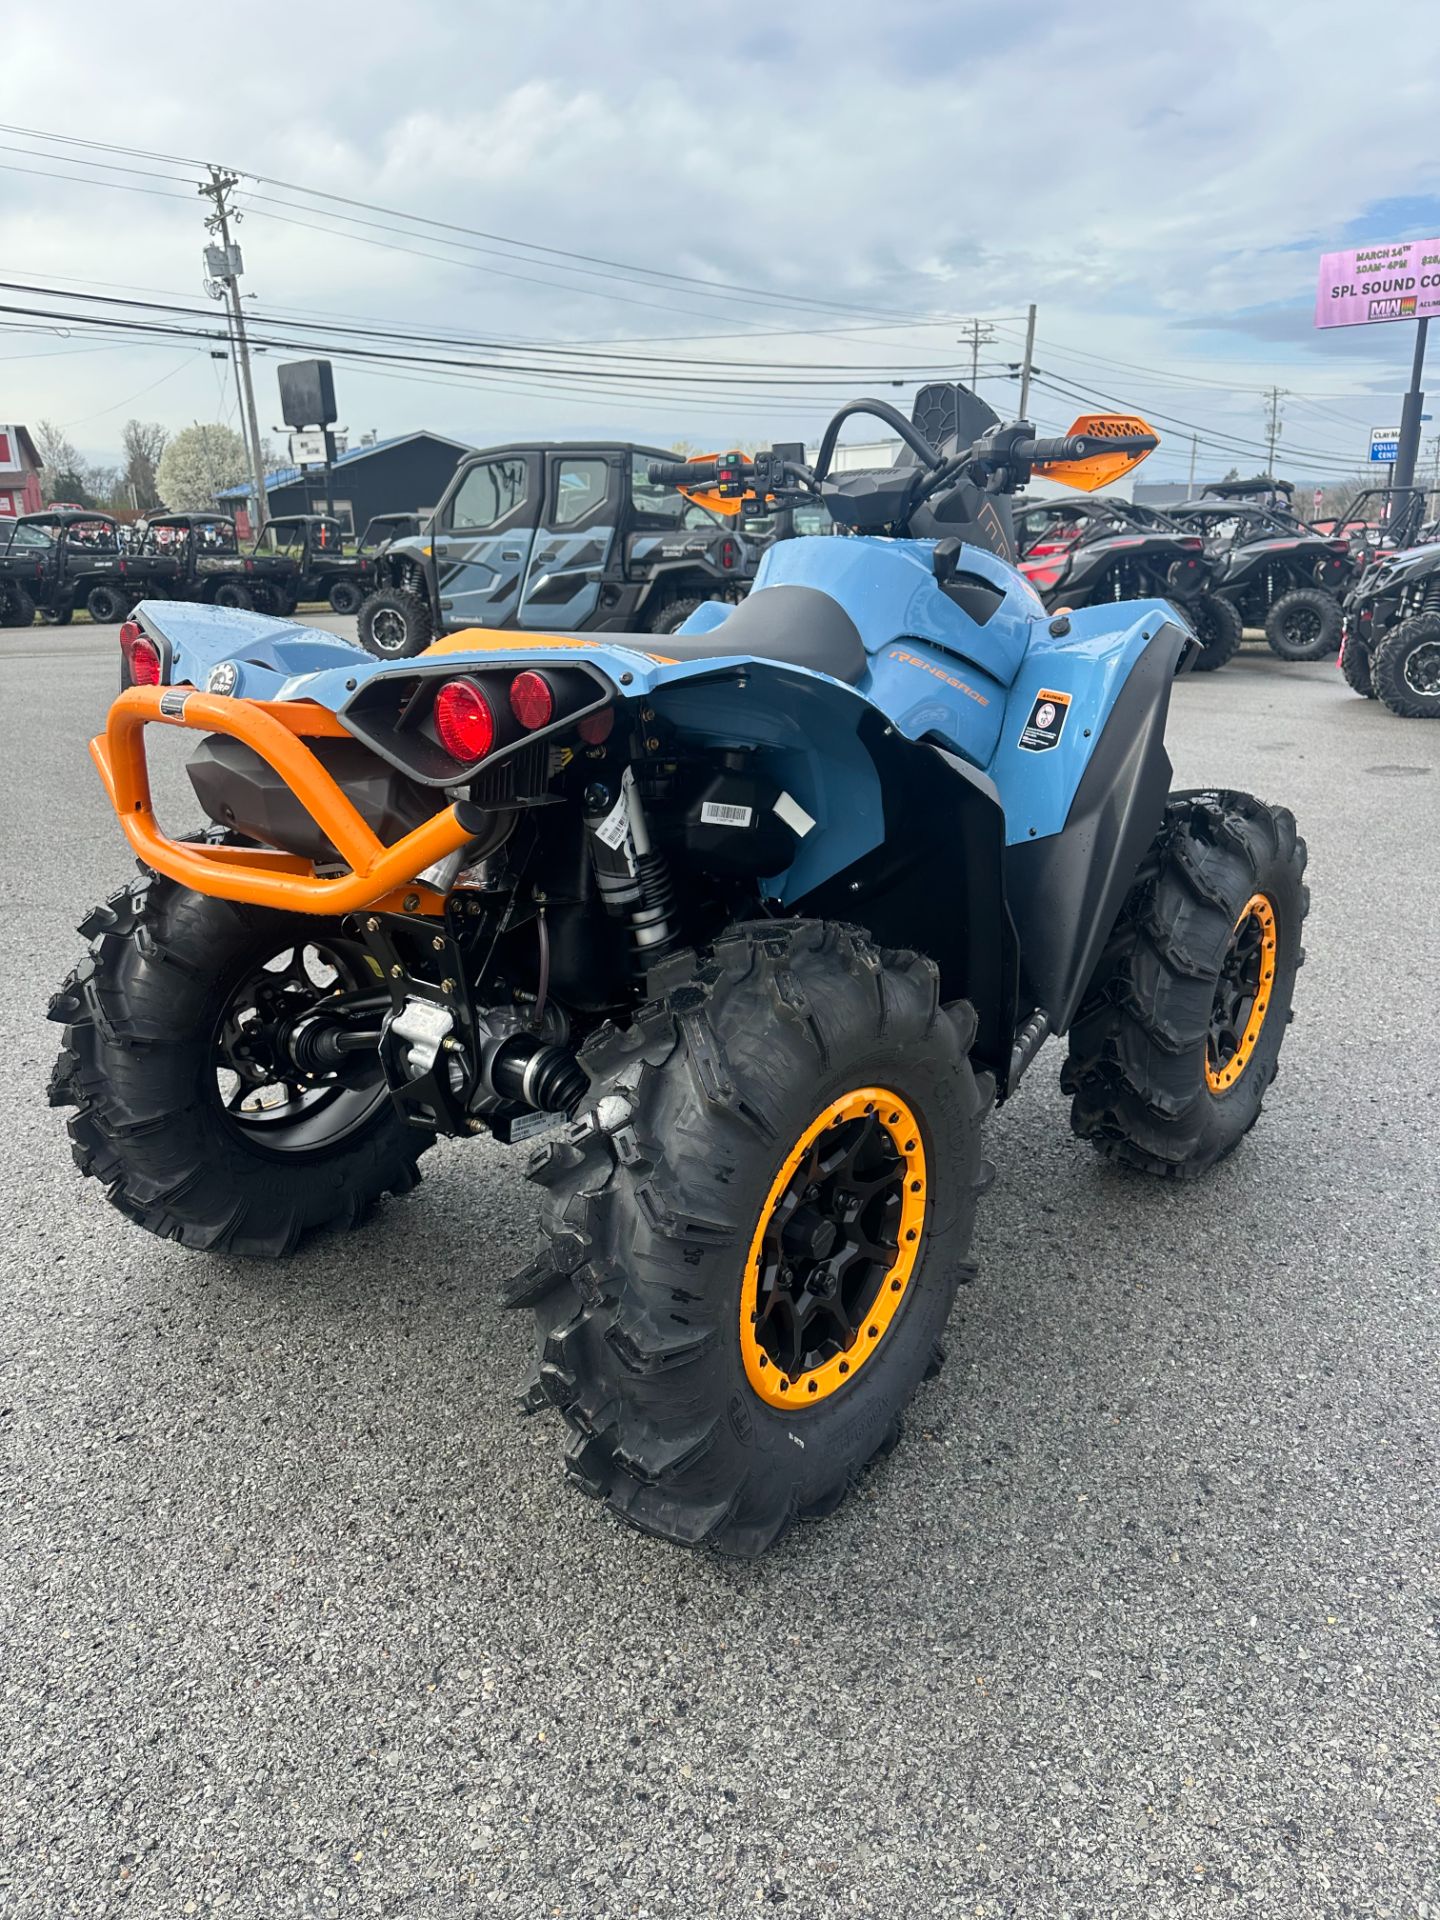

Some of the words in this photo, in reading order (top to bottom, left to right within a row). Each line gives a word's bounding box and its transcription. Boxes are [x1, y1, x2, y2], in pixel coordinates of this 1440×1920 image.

[1356, 249, 1390, 262] MARCH
[1331, 285, 1357, 298] SPL
[1361, 277, 1416, 295] SOUND
[1371, 299, 1401, 316] MW
[212, 683, 230, 692] BRP
[889, 650, 990, 708] RENEGADE
